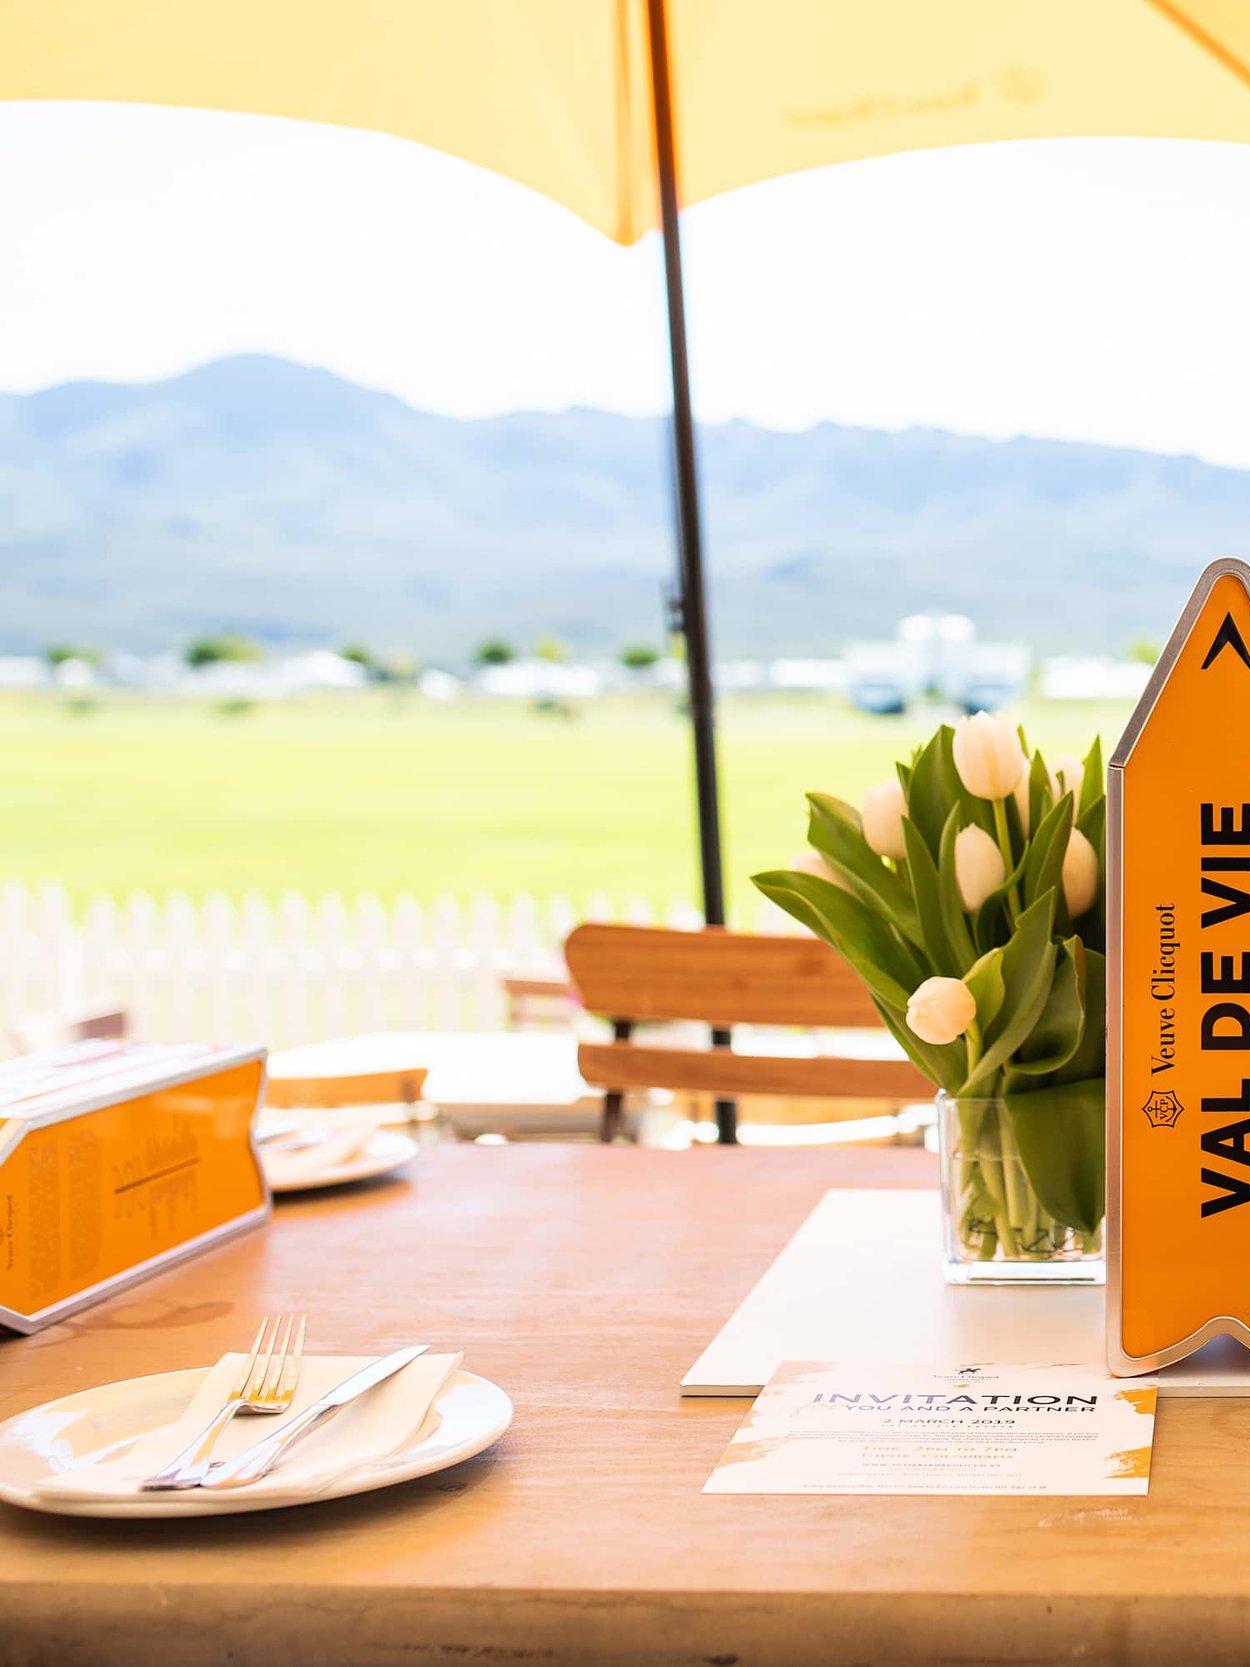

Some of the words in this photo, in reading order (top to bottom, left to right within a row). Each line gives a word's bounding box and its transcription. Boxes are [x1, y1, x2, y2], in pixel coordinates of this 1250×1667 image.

[1150, 902, 1181, 1001] Clicquot
[1150, 1008, 1175, 1075] Veuve
[813, 1393, 1098, 1405] INVITATION
